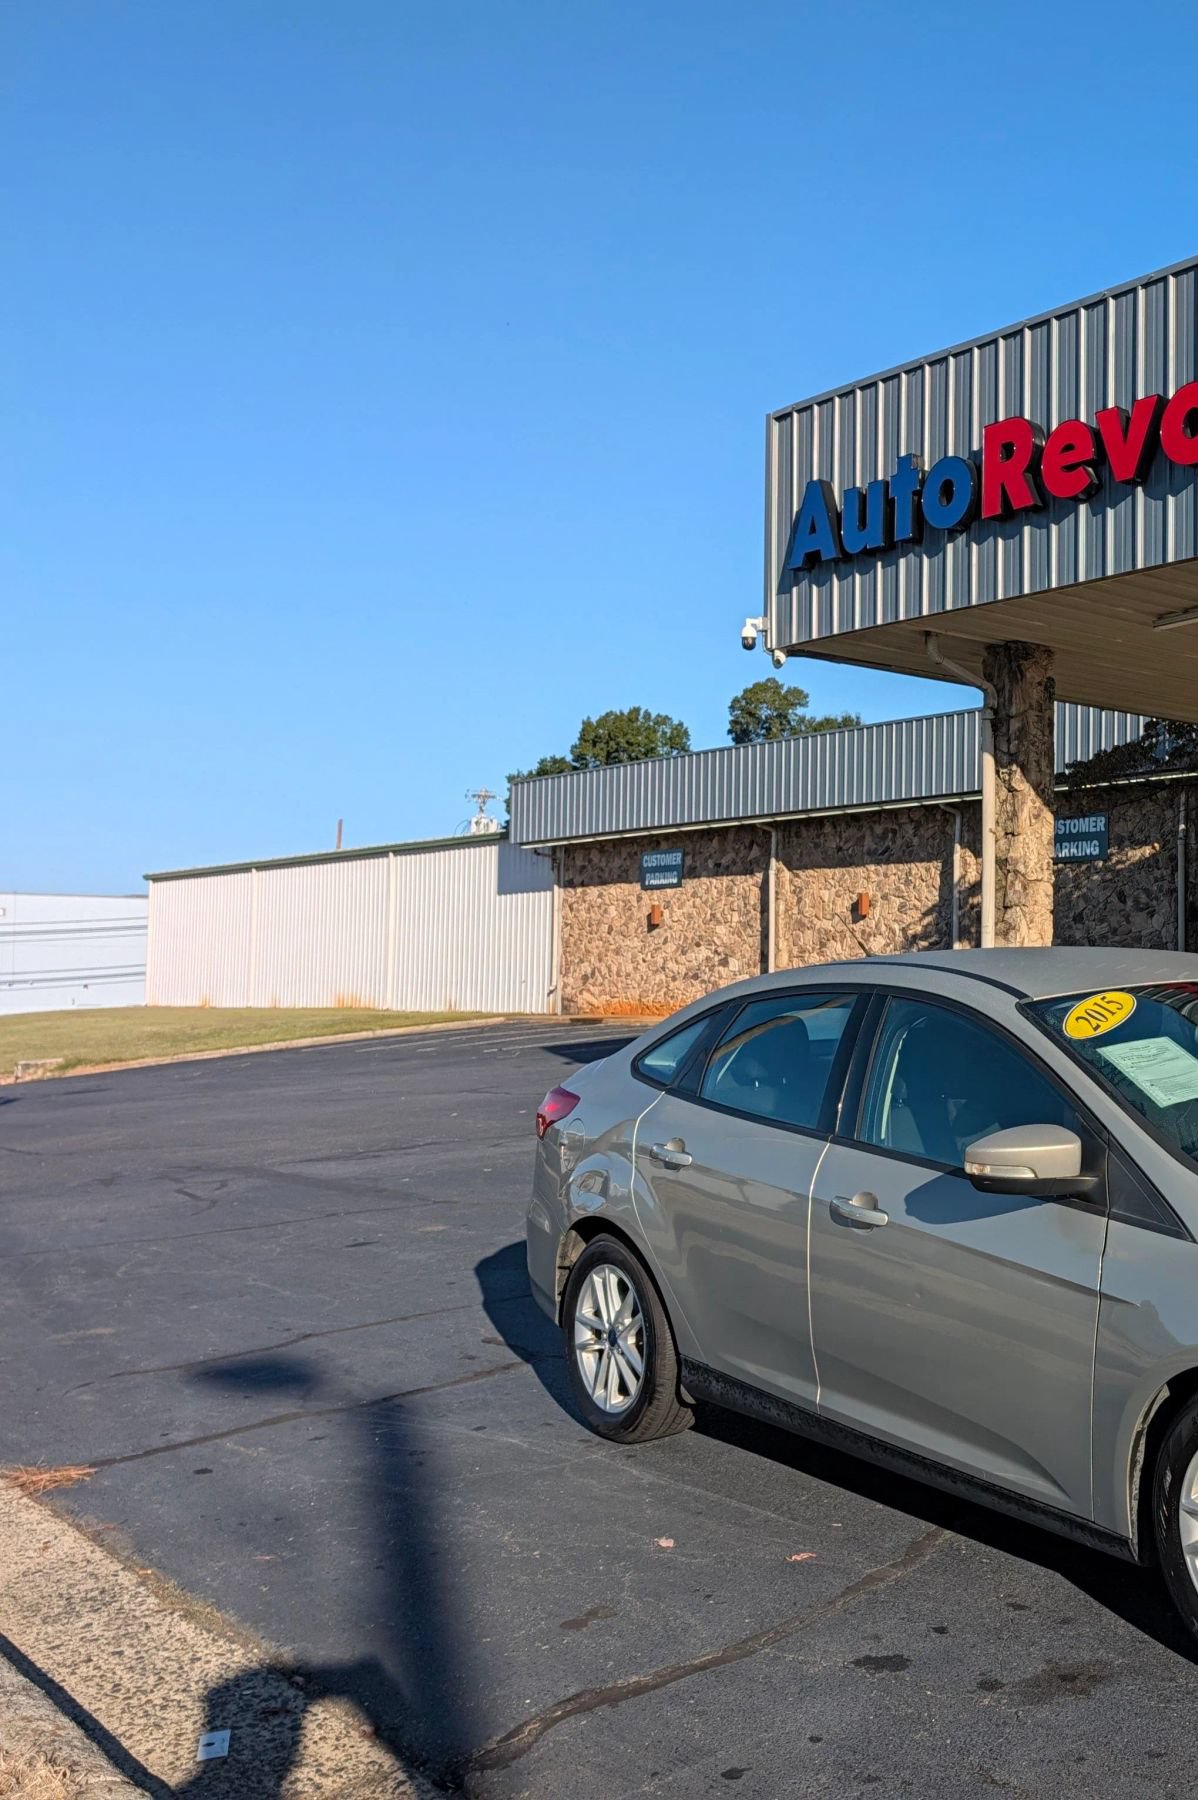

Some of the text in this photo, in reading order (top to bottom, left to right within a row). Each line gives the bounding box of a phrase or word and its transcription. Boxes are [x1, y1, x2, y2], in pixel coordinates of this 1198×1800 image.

[1055, 816, 1106, 835] STOMER
[1056, 840, 1100, 858] ARKING
[643, 852, 682, 868] CUSTOMER
[645, 871, 678, 886] PARKING
[1076, 996, 1125, 1032] 2015
